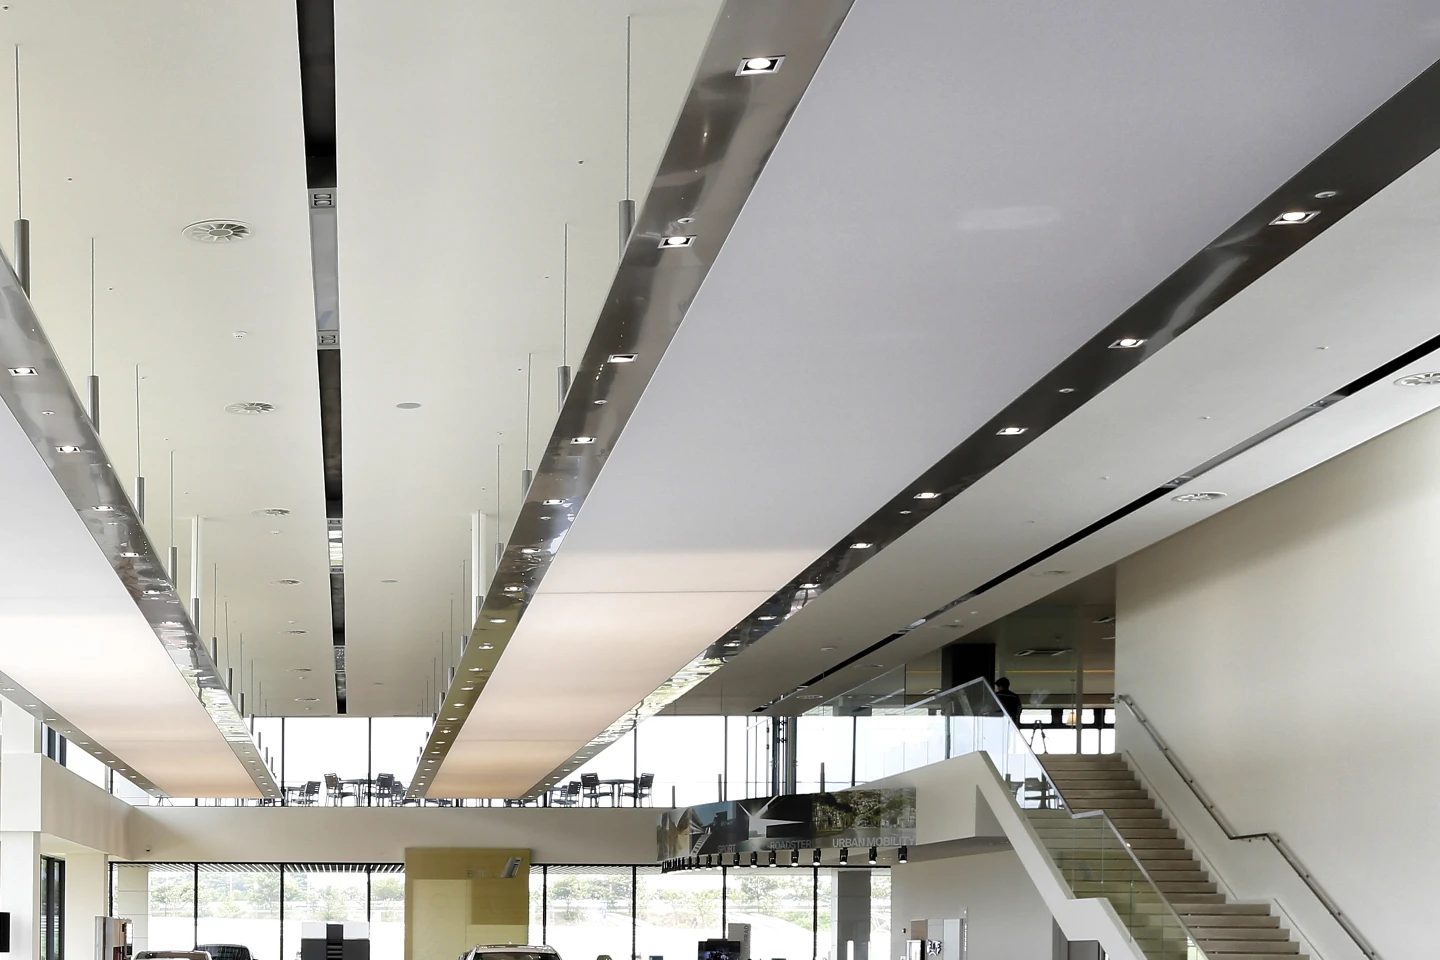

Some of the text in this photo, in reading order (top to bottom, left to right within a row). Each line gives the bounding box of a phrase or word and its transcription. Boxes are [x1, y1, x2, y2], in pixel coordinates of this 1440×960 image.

[769, 839, 812, 849] ROADSTER
[832, 836, 917, 848] URBAN MOBILITY
[717, 843, 737, 854] SPORT
